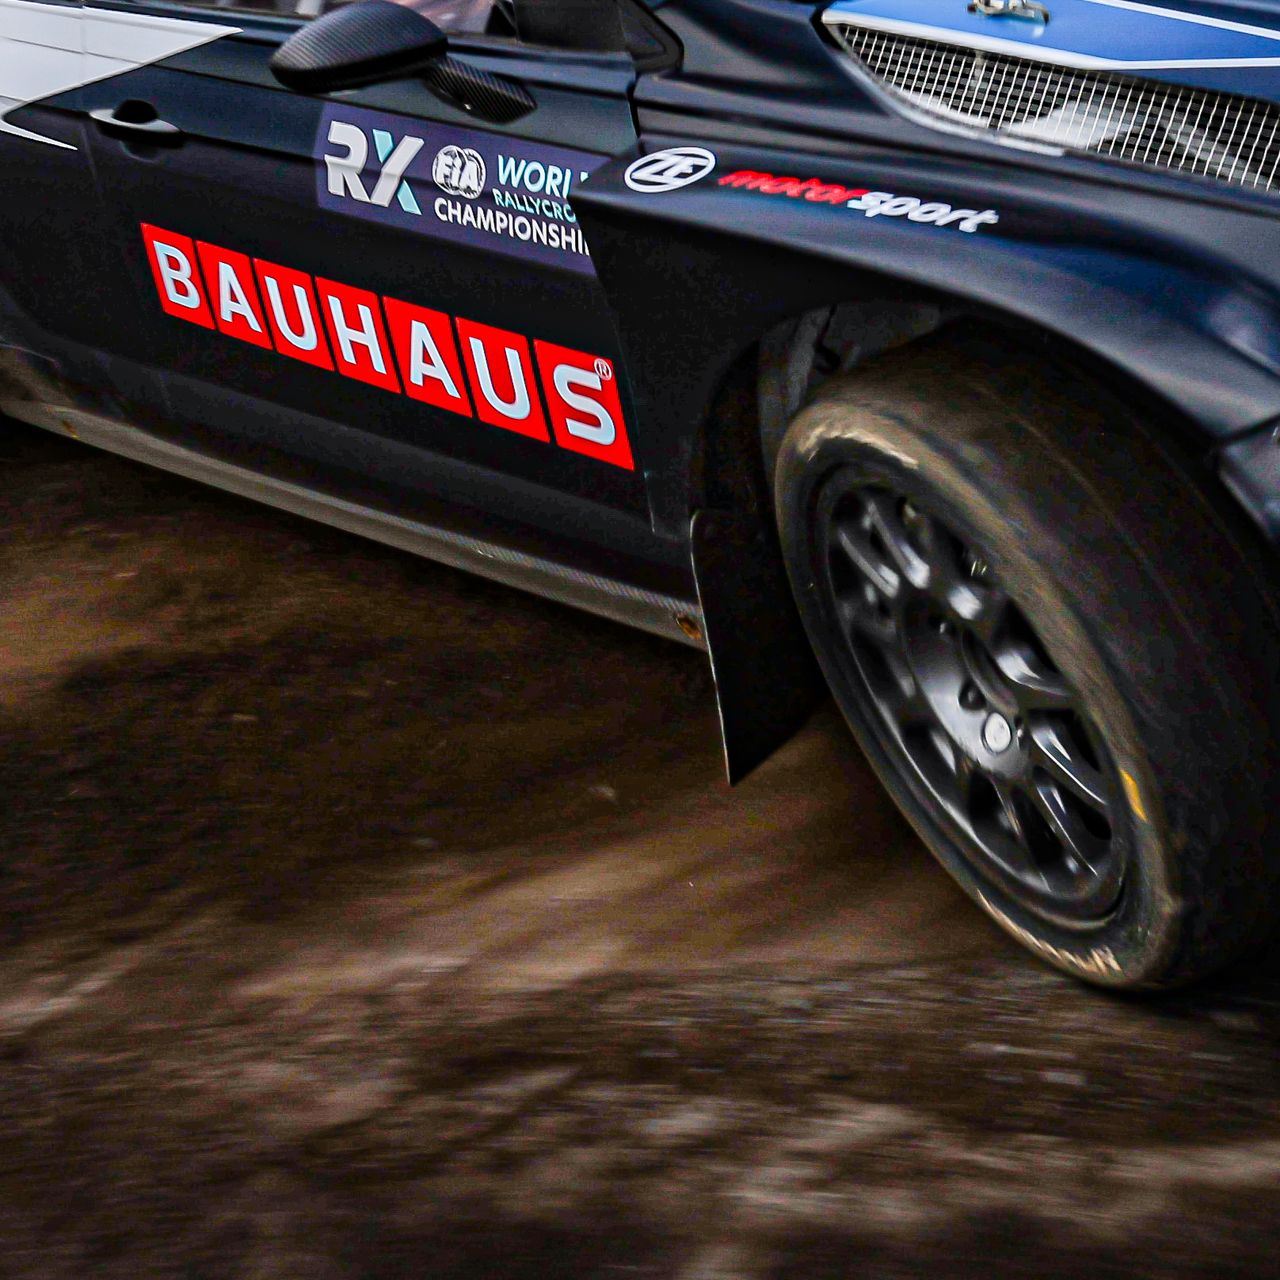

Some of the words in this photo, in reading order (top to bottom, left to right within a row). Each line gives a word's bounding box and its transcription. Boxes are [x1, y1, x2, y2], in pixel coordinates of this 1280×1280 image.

[324, 119, 425, 216] RX
[435, 148, 484, 195] FIA
[497, 154, 589, 199] WORL
[627, 149, 712, 191] ZF
[719, 169, 1000, 234] motorsport
[434, 197, 590, 256] CHAMPIONSHI
